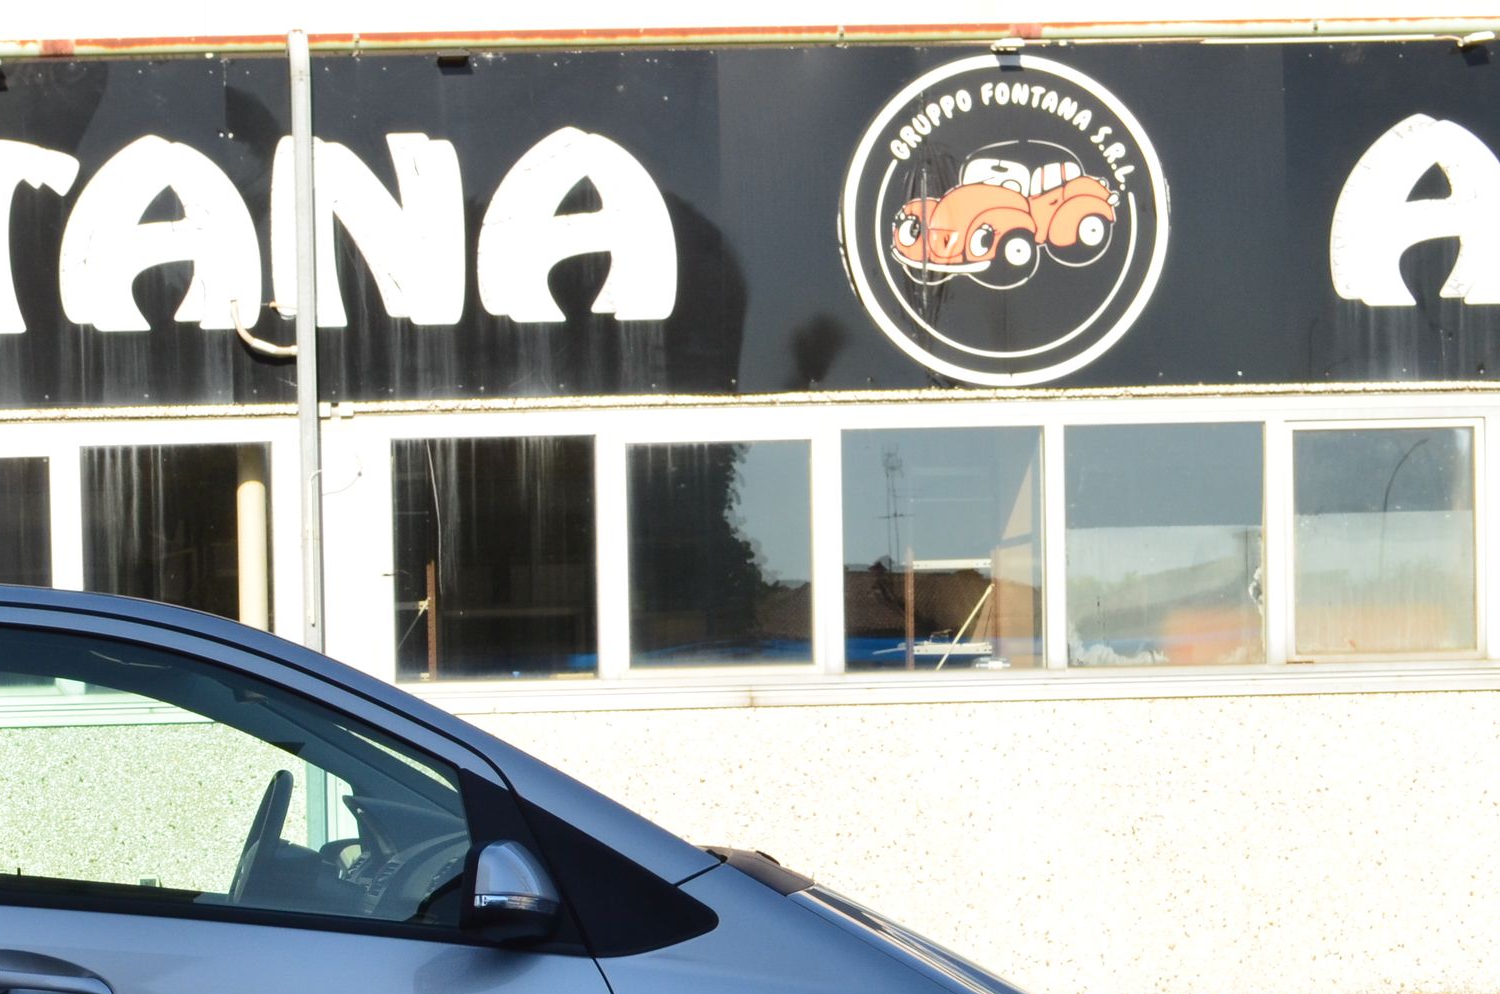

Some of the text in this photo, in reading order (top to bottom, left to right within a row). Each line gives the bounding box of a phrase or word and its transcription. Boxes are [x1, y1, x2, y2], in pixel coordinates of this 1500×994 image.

[890, 81, 1135, 191] GRUPPO FONTANA S.R.L.
